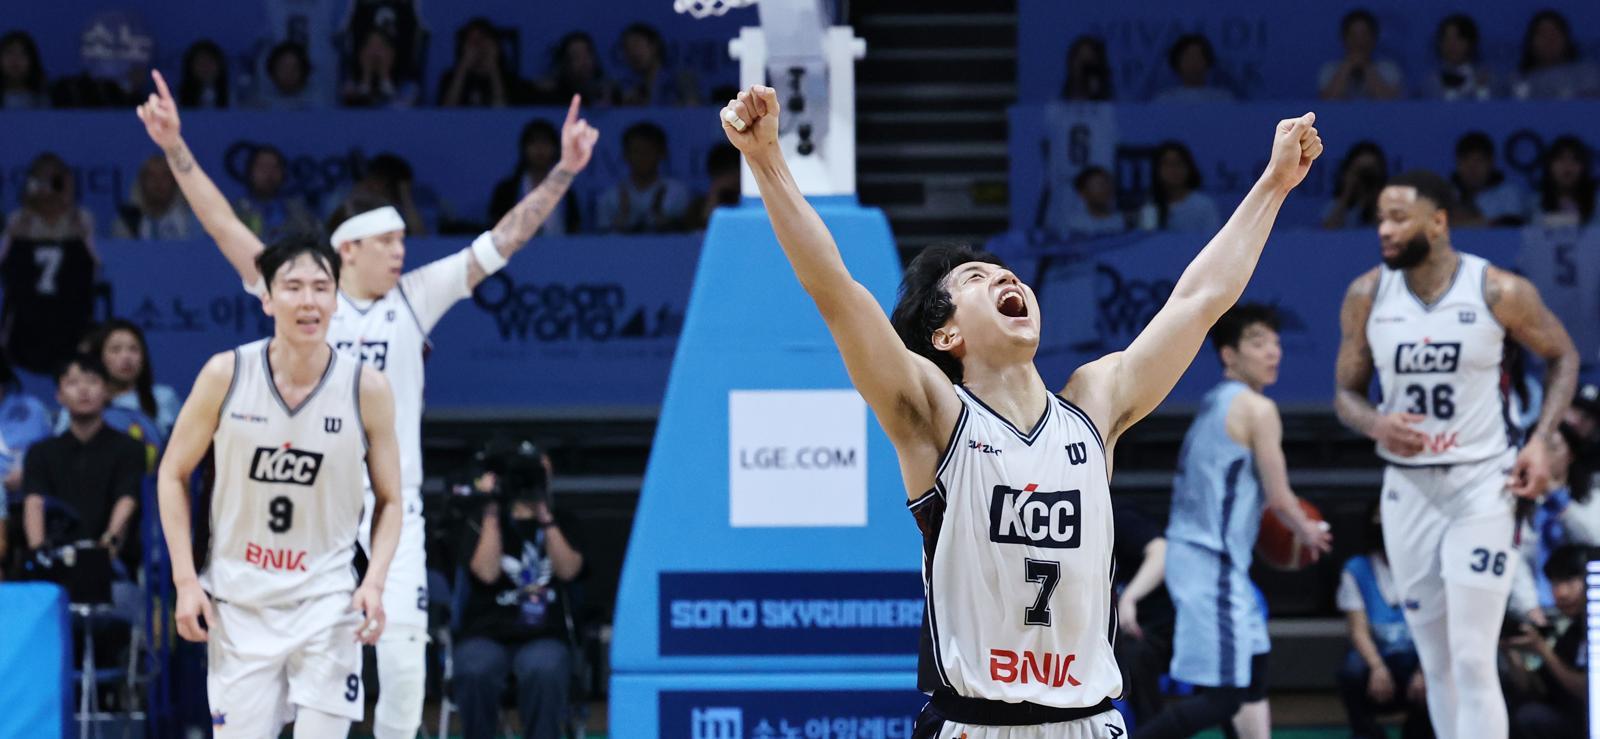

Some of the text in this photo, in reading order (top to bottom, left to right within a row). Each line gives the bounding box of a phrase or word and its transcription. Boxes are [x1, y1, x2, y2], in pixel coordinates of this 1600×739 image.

[34, 246, 63, 296] 7
[1553, 244, 1577, 287] 5
[1399, 338, 1457, 373] KCC
[1406, 384, 1455, 420] 36
[254, 444, 316, 483] KCC
[740, 447, 858, 469] LGE.COM
[268, 496, 293, 533] 9
[998, 484, 1075, 543] KCC
[246, 543, 306, 571] BNK
[1471, 548, 1507, 576] 36
[1025, 558, 1060, 626] 7
[990, 649, 1082, 687] BNK
[345, 674, 359, 703] 9
